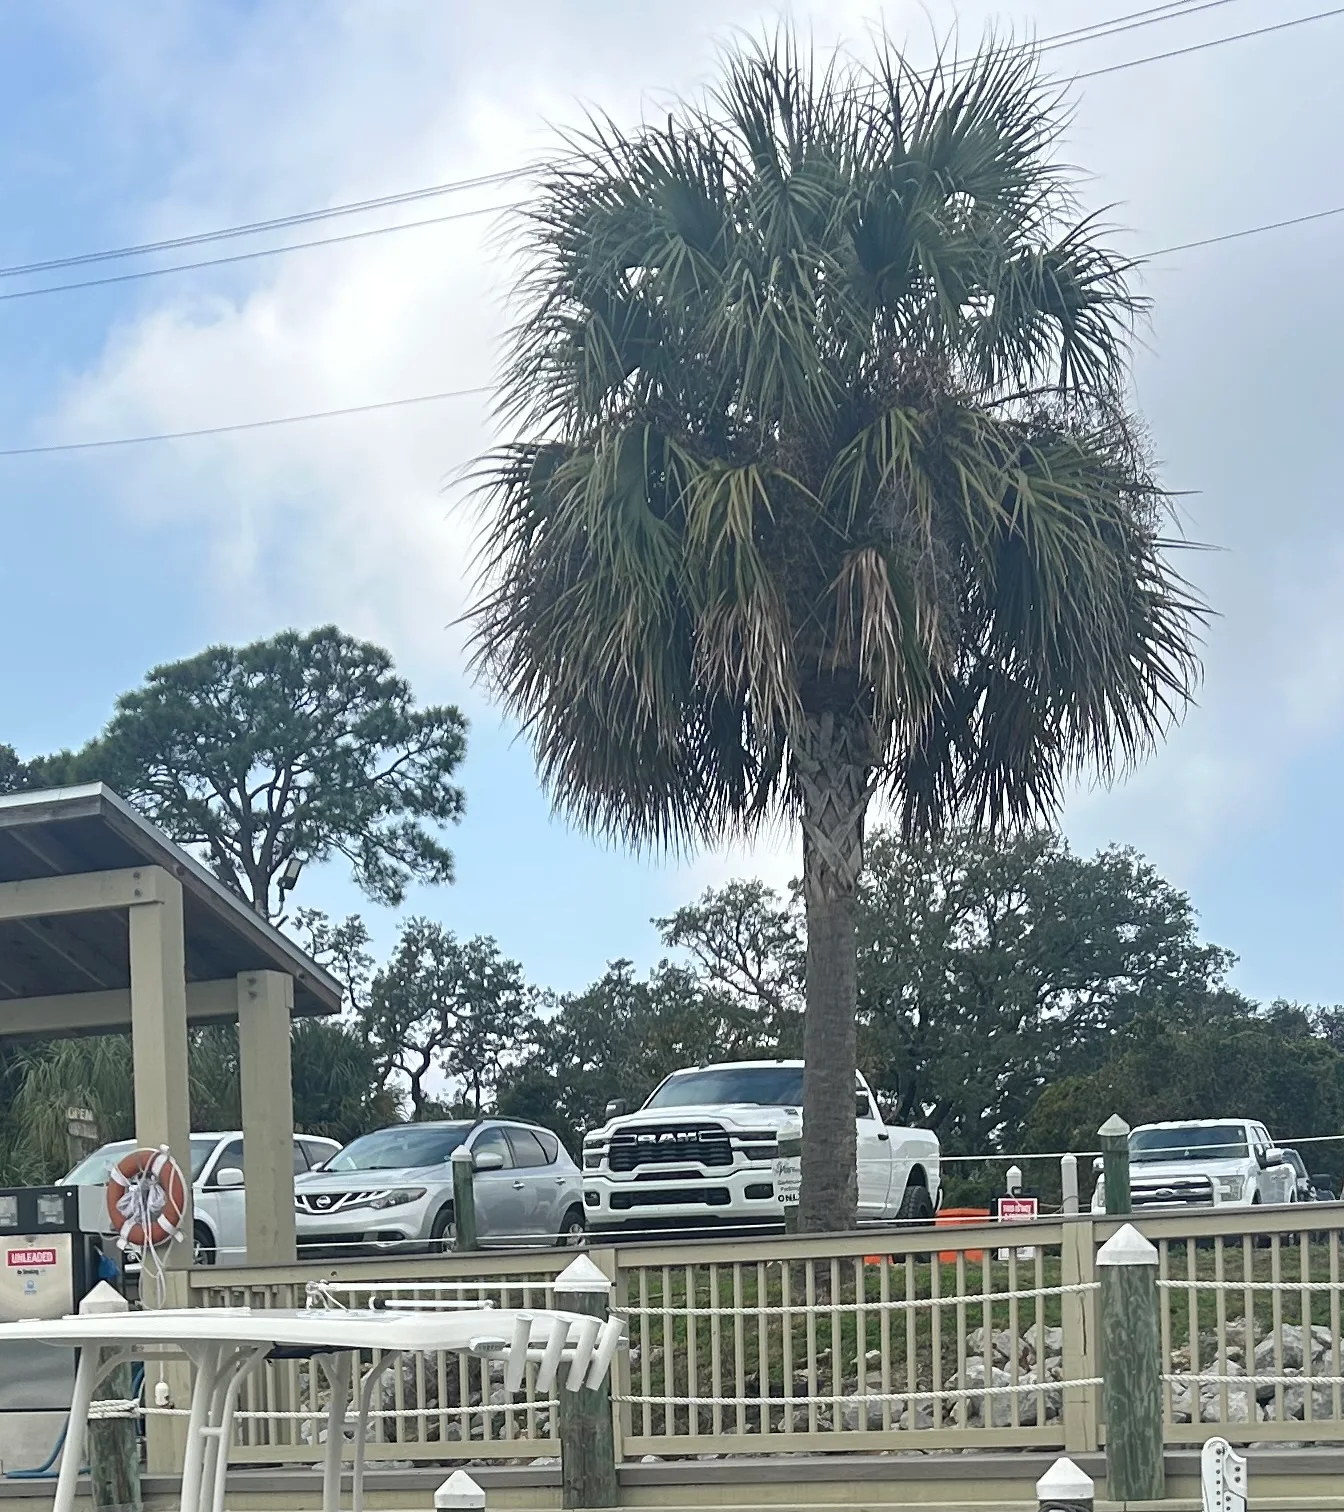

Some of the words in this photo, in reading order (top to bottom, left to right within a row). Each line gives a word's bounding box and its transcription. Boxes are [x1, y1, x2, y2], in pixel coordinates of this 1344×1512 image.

[68, 1106, 93, 1120] OPEN
[637, 1132, 698, 1144] RAM
[777, 1194, 800, 1202] ONL
[11, 1251, 54, 1264] UNLEADED
